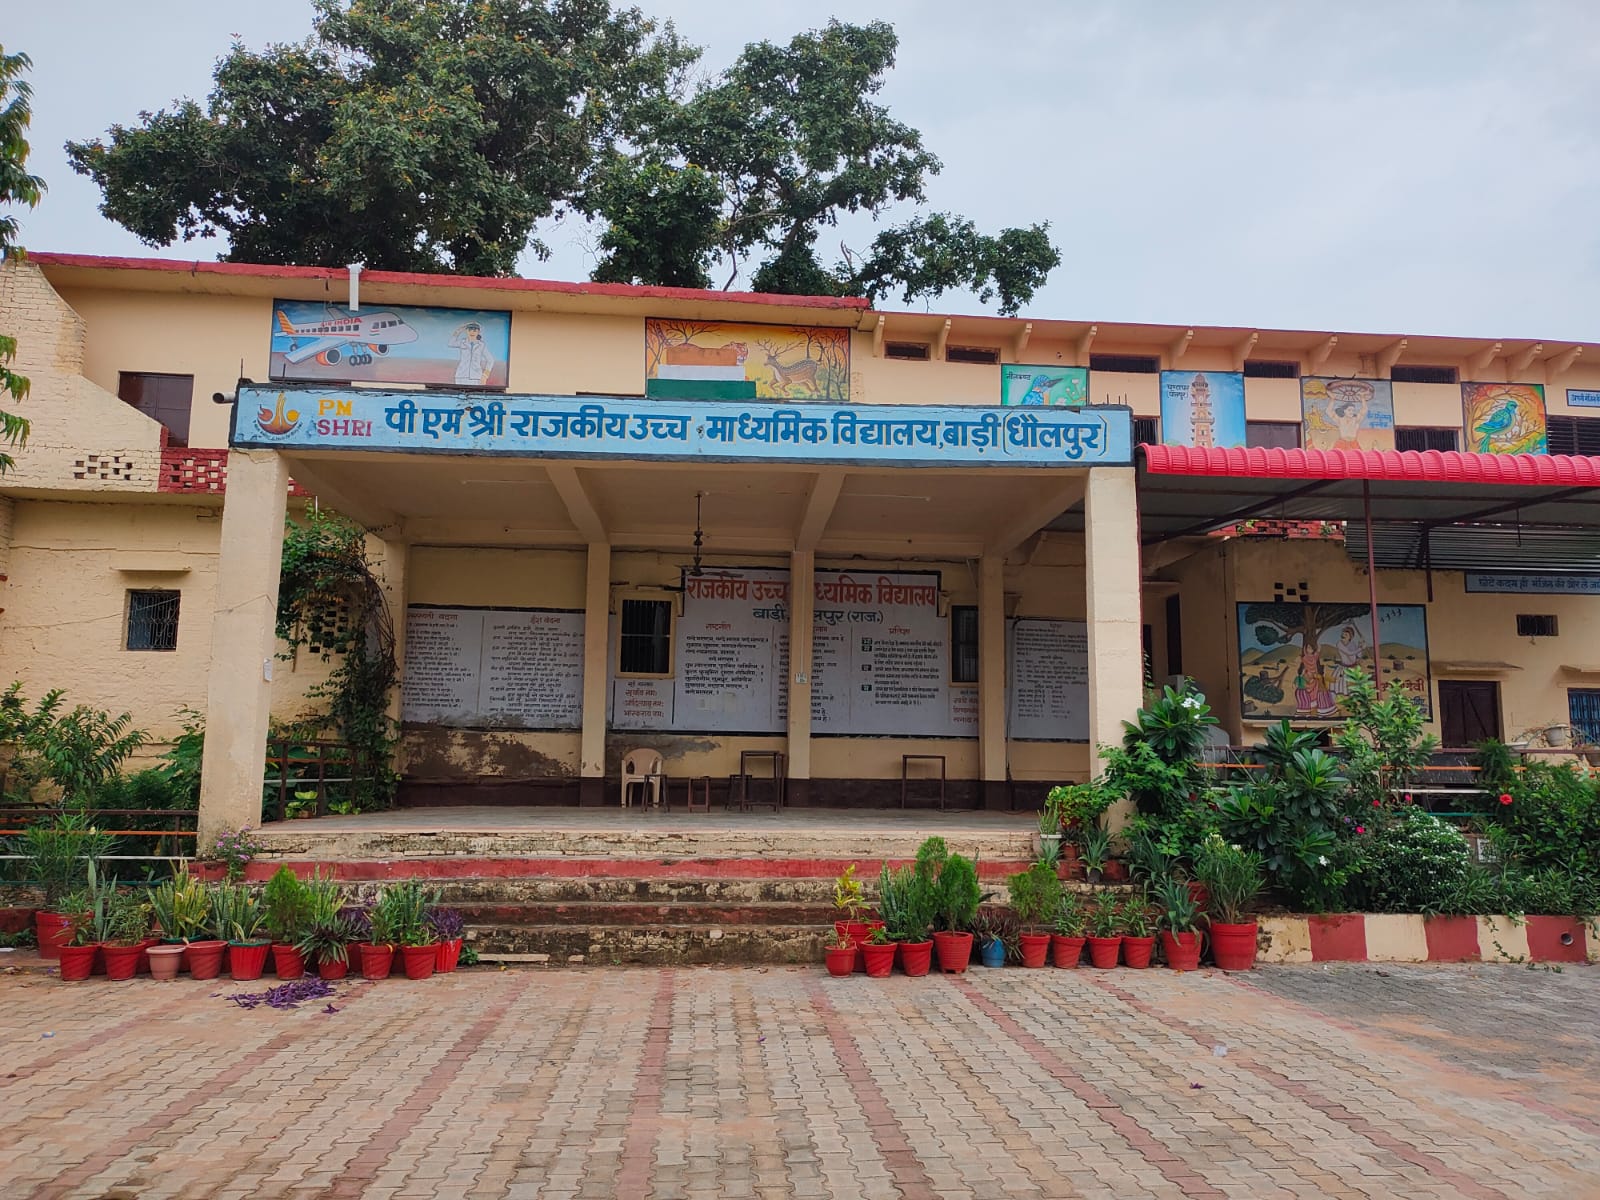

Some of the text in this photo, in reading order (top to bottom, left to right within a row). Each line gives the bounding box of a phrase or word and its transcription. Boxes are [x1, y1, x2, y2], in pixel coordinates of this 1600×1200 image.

[335, 317, 362, 325] INDIA
[318, 399, 354, 416] PM
[317, 418, 372, 438] SHRI
[384, 400, 415, 434] पी
[421, 407, 464, 438] एम
[468, 400, 505, 438] श्री
[509, 404, 630, 441] राजकीय
[629, 413, 691, 442] उच्च
[706, 411, 827, 445] माध्यमिक
[686, 576, 750, 601] राजकीय
[813, 574, 872, 605] ध्यमिक
[876, 576, 937, 607] विद्यालय
